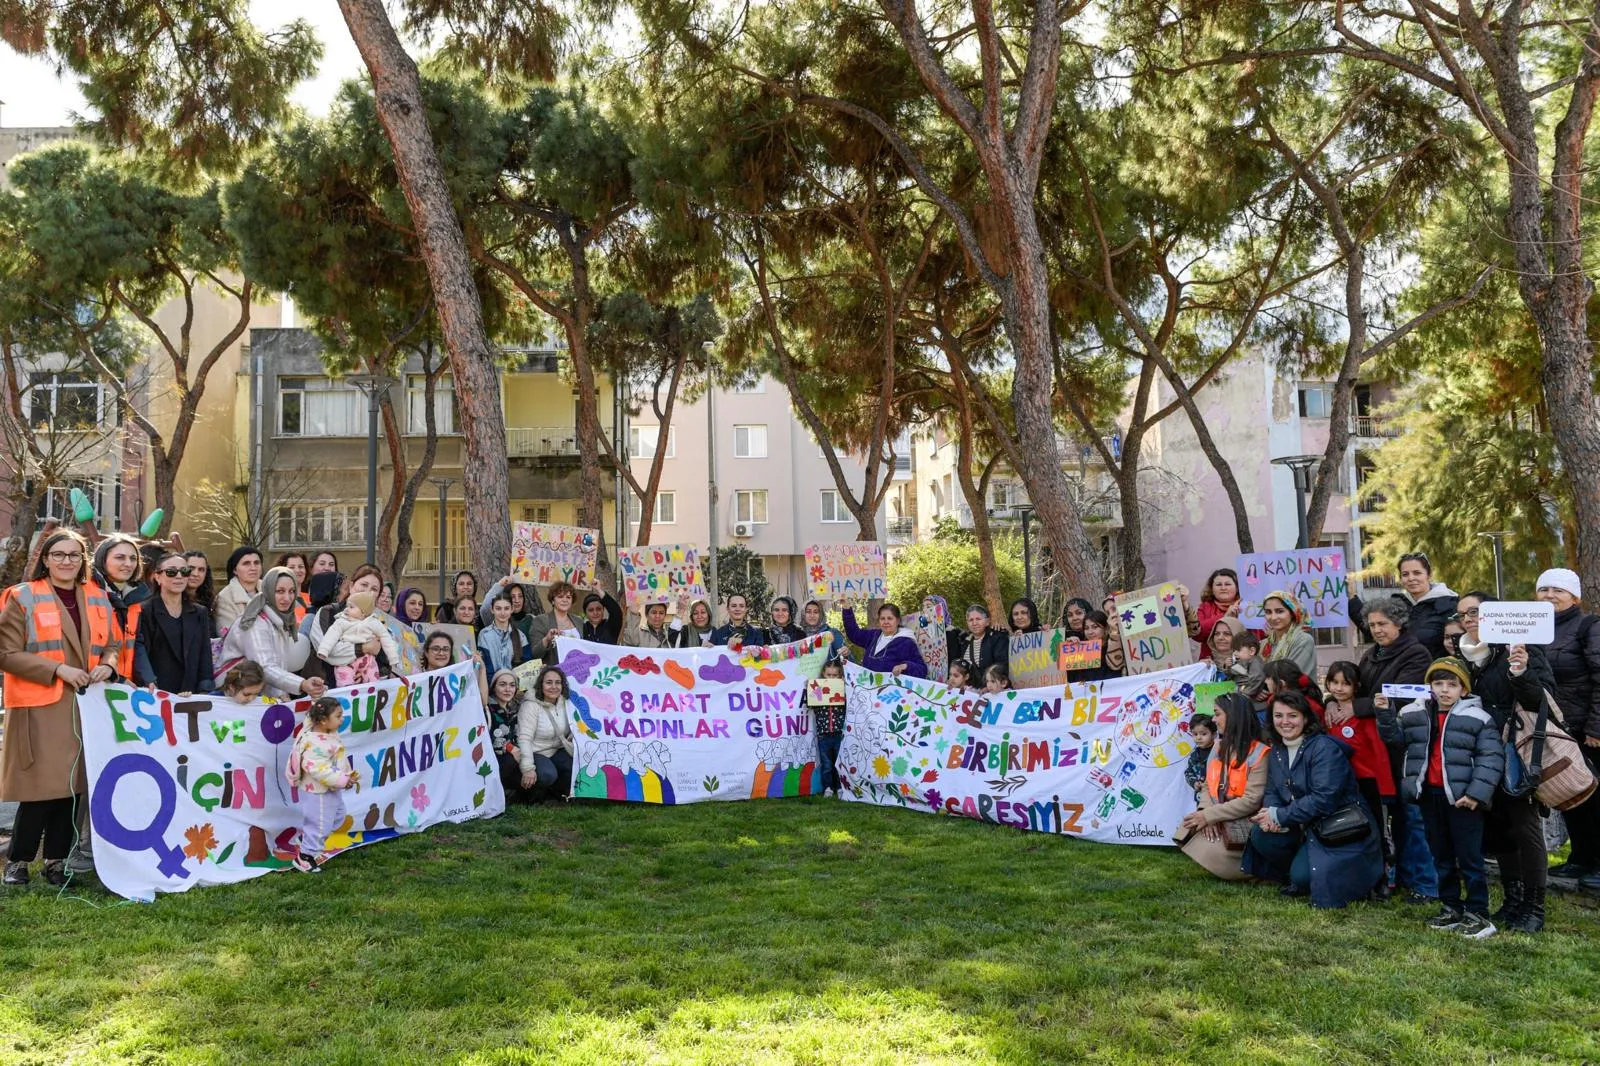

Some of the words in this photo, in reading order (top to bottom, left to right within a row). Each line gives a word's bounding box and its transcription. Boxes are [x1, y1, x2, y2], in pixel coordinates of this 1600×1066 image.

[1264, 557, 1323, 575] KADIN
[1010, 632, 1043, 656] KADIN
[620, 690, 635, 713] 8
[641, 692, 711, 713] MART
[728, 687, 808, 713] DÜNYA
[956, 699, 1003, 728] SEN
[1012, 698, 1061, 724] BEN
[603, 716, 730, 739] KADINLAR
[745, 710, 808, 738] GÜNÜ
[177, 754, 265, 813] İÇİN
